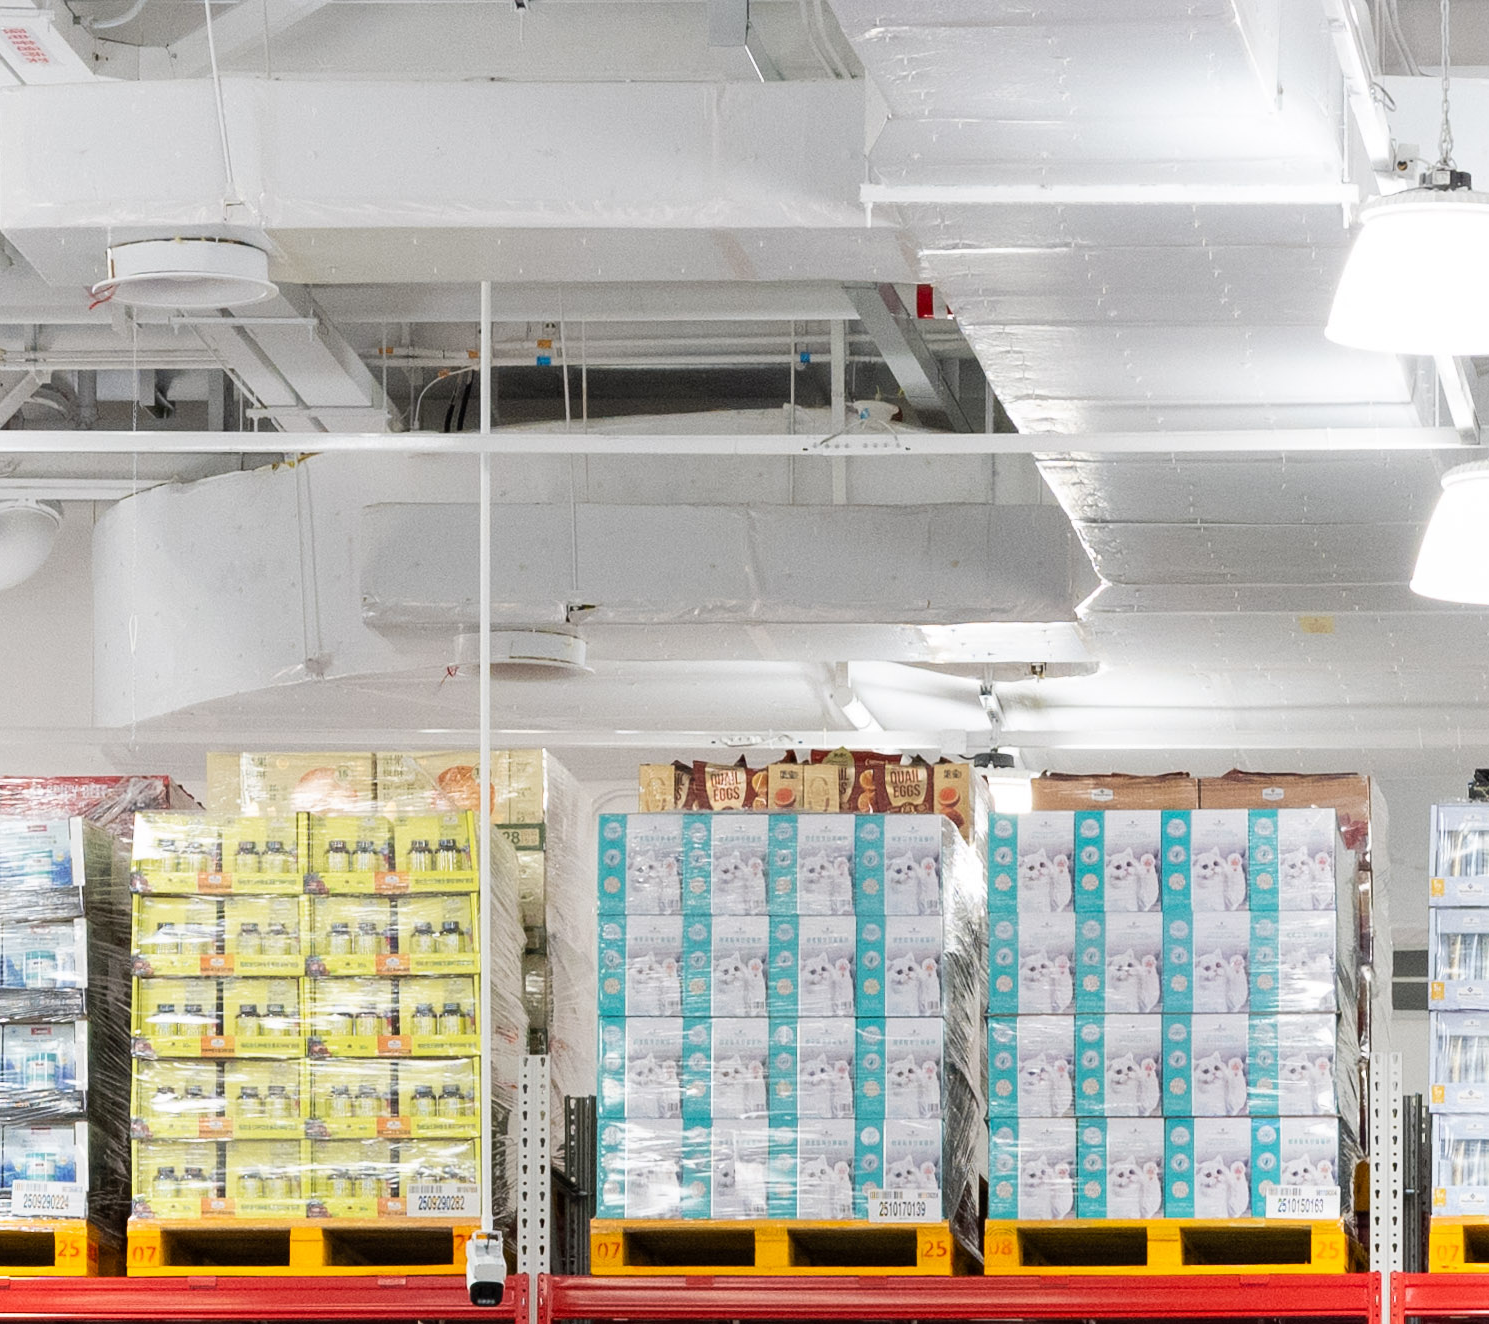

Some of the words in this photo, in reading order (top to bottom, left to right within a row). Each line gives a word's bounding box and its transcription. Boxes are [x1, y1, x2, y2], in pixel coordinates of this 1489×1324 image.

[711, 769, 739, 785] QUAIL
[713, 786, 740, 800] EGGS
[878, 1201, 927, 1219] 2510170139
